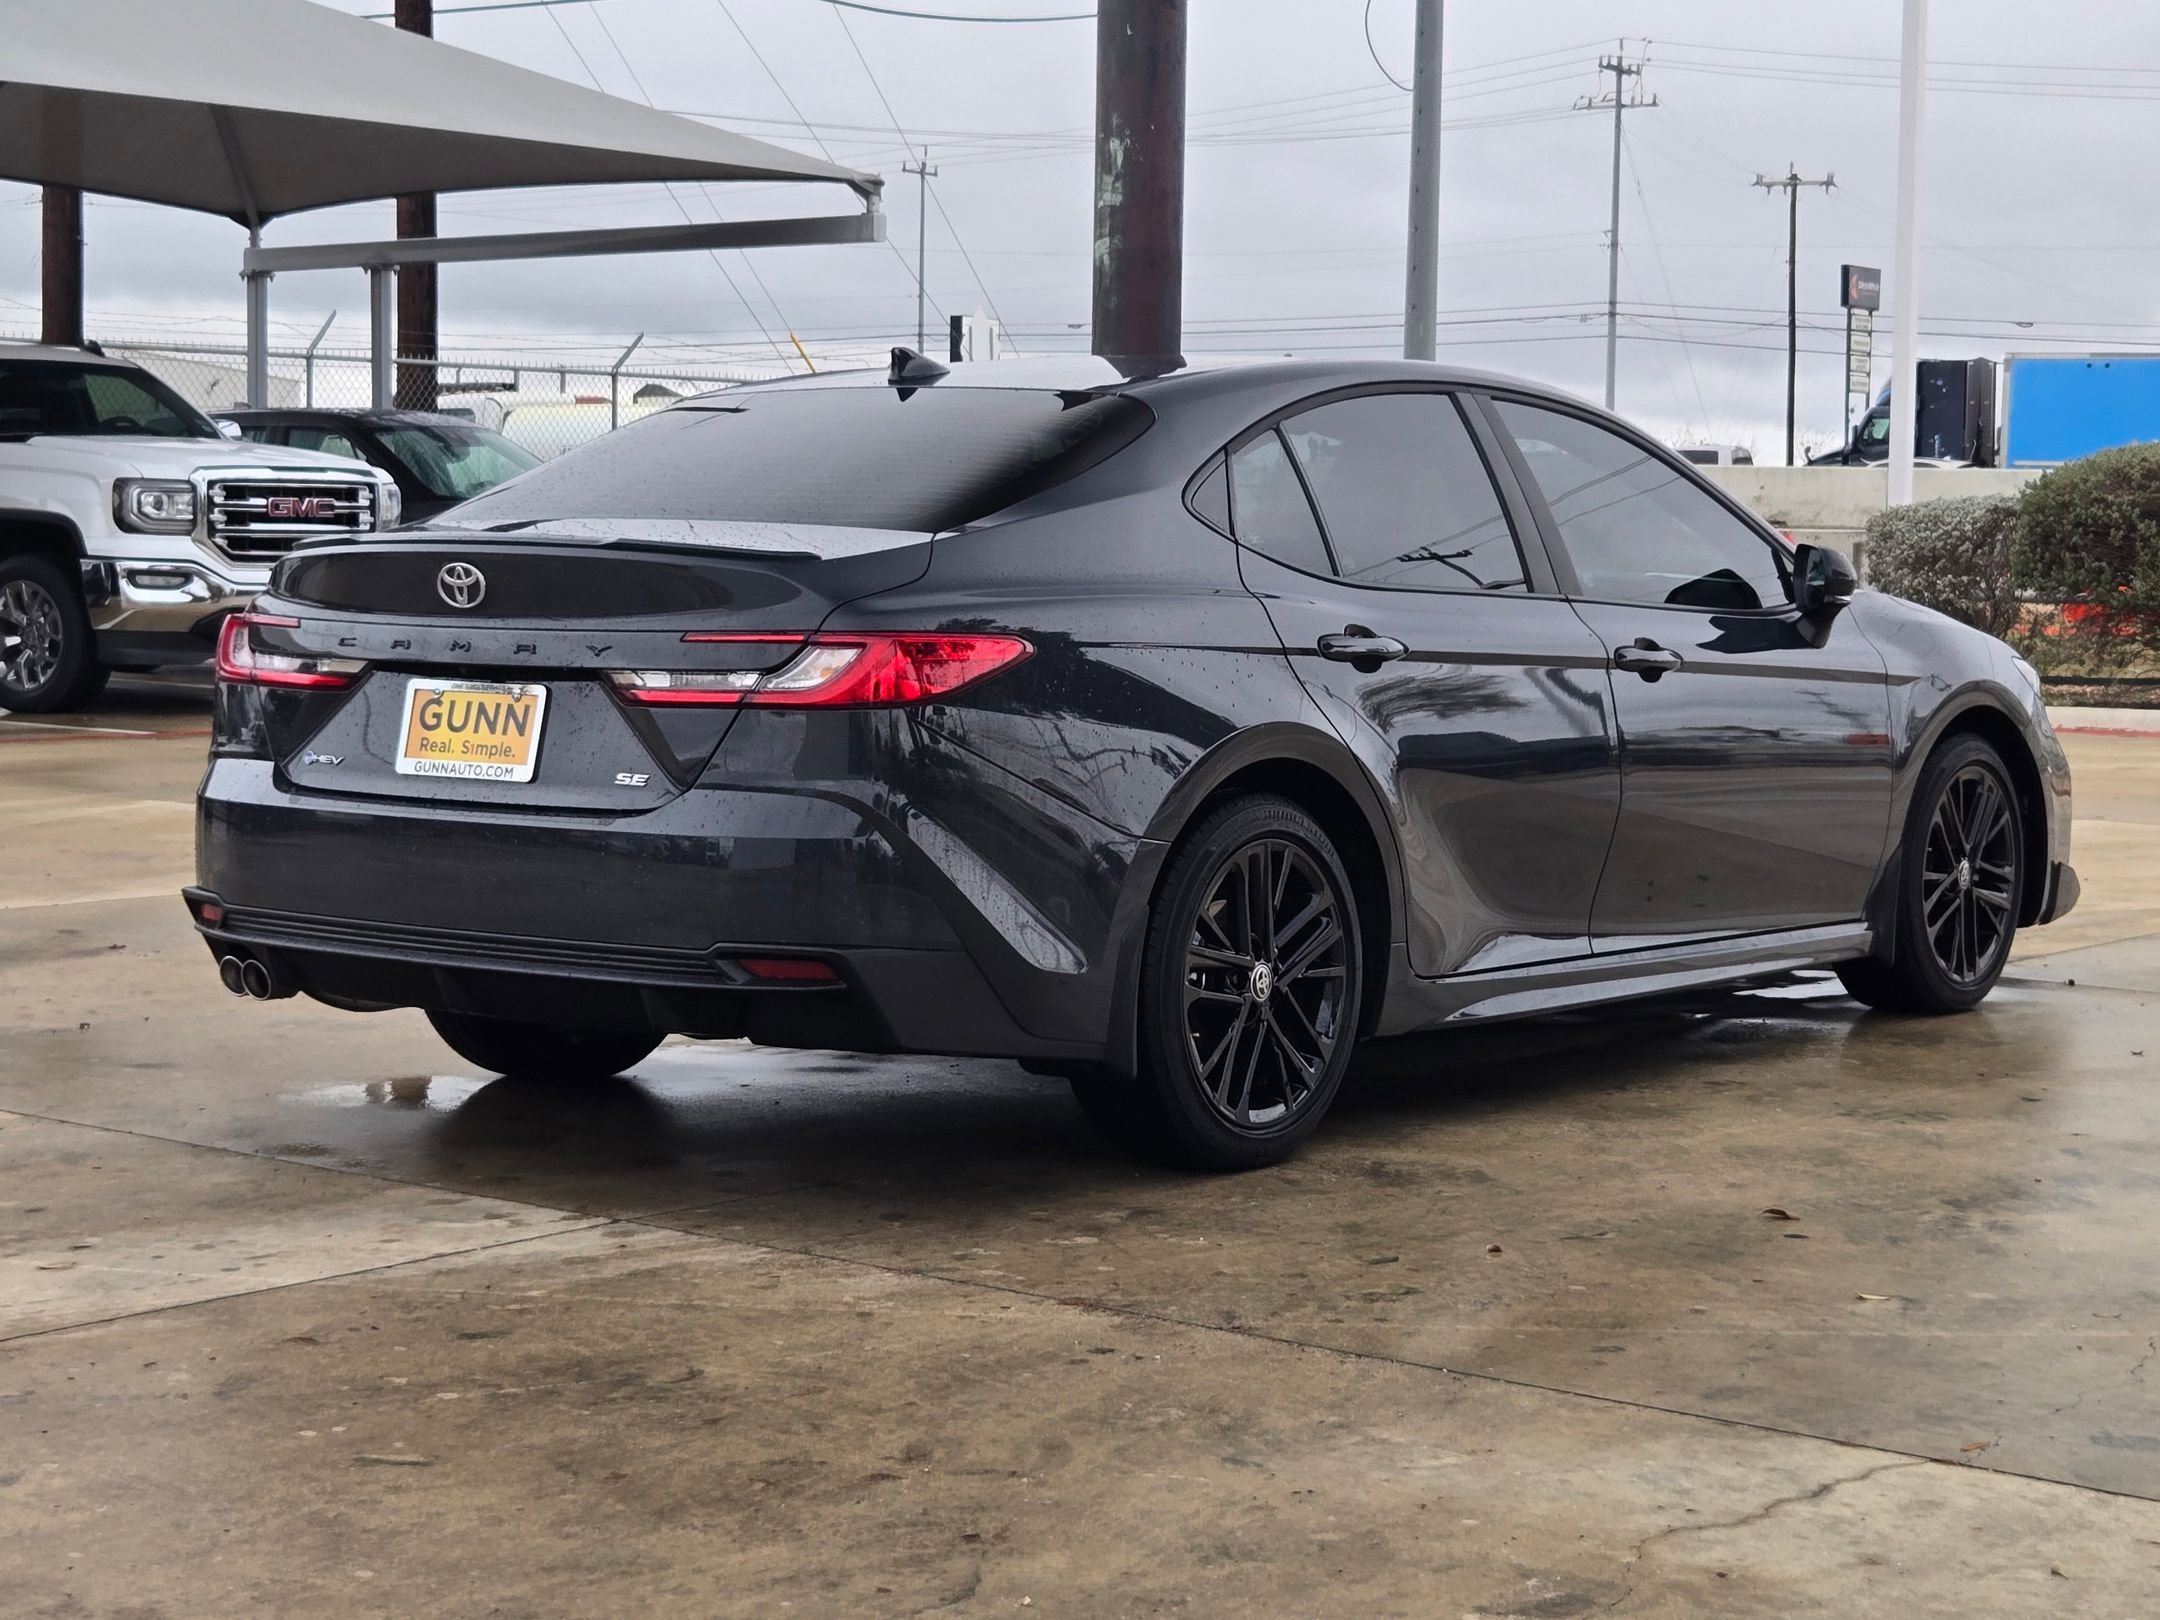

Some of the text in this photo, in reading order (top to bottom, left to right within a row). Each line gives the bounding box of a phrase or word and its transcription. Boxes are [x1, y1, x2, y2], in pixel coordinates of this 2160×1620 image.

[268, 497, 336, 517] GMC
[338, 637, 613, 657] CAMRY
[420, 698, 531, 737] GUNN
[420, 737, 454, 754] Real.
[312, 754, 345, 765] HEV
[414, 760, 515, 779] GUNNAUTO.COM
[613, 772, 650, 787] SE
